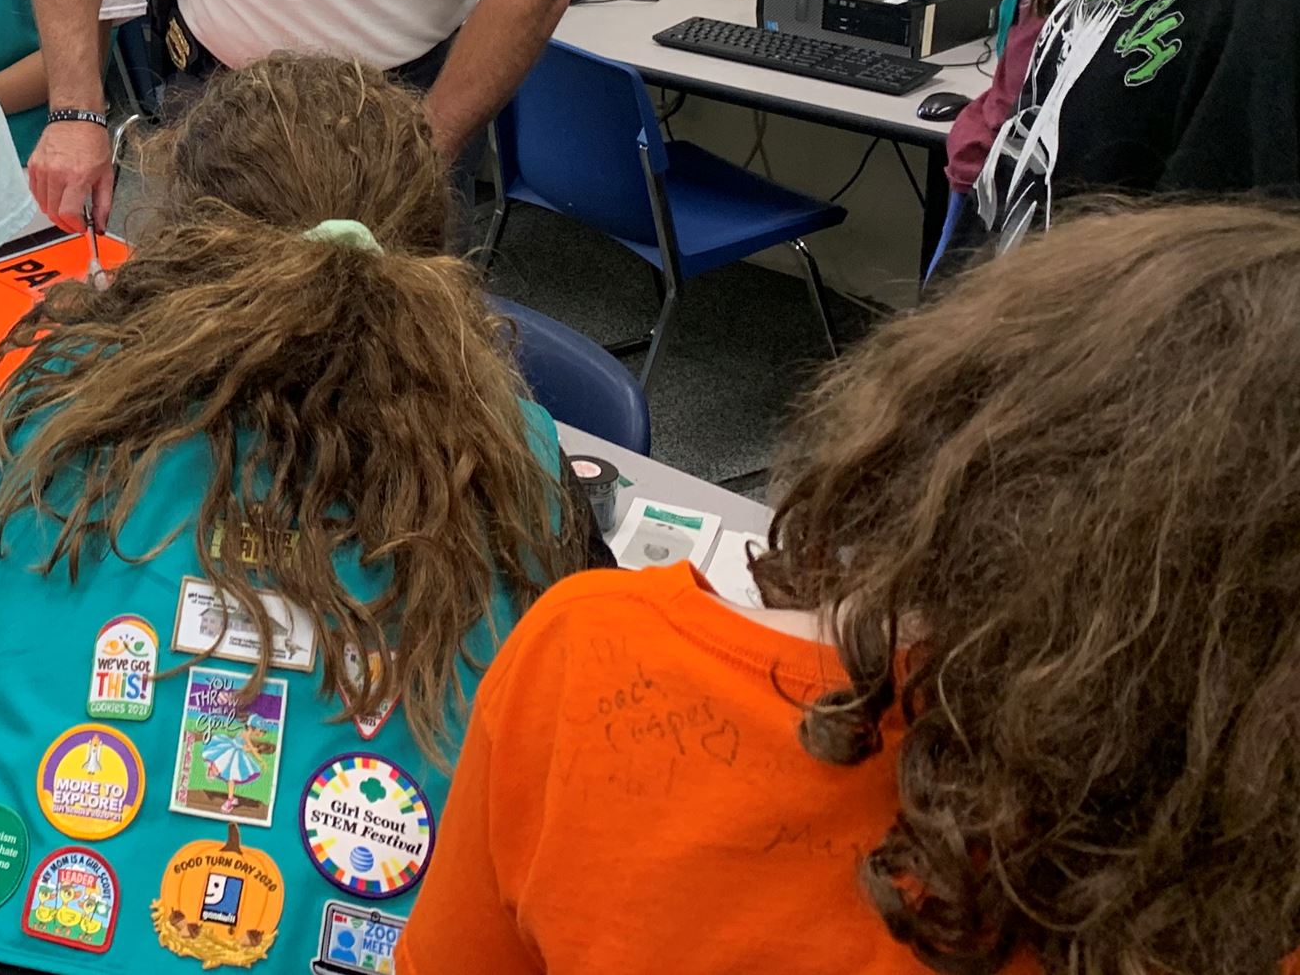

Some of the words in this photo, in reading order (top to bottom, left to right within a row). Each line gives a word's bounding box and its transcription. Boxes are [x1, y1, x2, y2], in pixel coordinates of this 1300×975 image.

[207, 675, 234, 692] YOU
[128, 704, 148, 715] 2021
[56, 778, 100, 795] MORE
[104, 783, 124, 798] TO
[53, 790, 123, 813] EXPLORE!
[330, 799, 360, 819] Girl
[362, 809, 407, 835] Scout
[310, 809, 359, 835] STEM
[360, 825, 423, 857] Festival
[0, 844, 19, 858] hate
[50, 856, 70, 871] MOM
[70, 854, 78, 865] IS
[79, 855, 85, 865] A
[85, 858, 101, 875] GIRL
[100, 872, 112, 900] SCOUT
[61, 870, 96, 888] LEADER
[173, 856, 203, 874] GOOD
[204, 855, 234, 868] TURN
[233, 859, 257, 875] DAY
[253, 870, 278, 893] 2020
[362, 938, 394, 957] MEET
